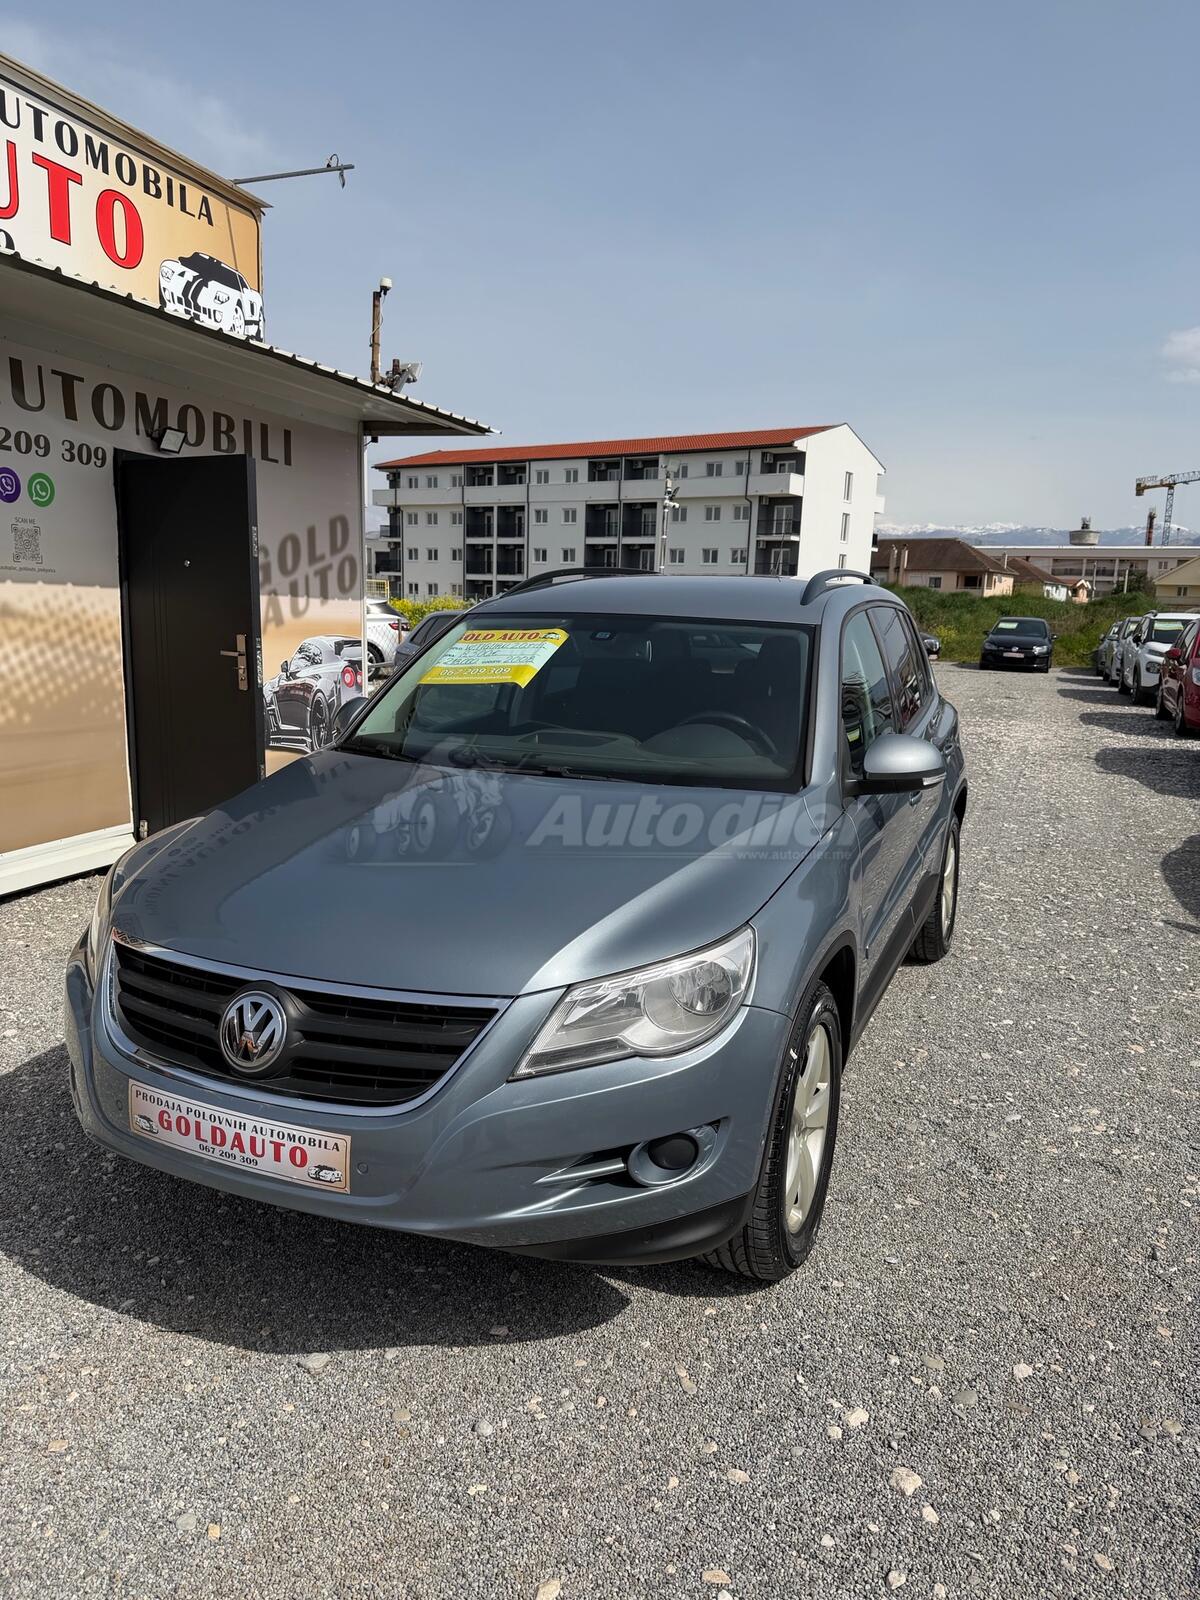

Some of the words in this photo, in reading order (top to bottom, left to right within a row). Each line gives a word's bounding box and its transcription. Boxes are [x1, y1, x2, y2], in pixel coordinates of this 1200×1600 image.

[61, 439, 107, 468] 309
[262, 553, 358, 635] AUTO
[497, 632, 540, 640] AUTO
[135, 1090, 182, 1113] PRODAJA
[186, 1106, 247, 1132] POLOVNIH
[250, 1124, 340, 1152] AUTOMOBILA
[158, 1109, 308, 1168] GOLDAUTO
[198, 1143, 216, 1154] 067
[218, 1149, 237, 1161] 209
[239, 1155, 258, 1167] 309
